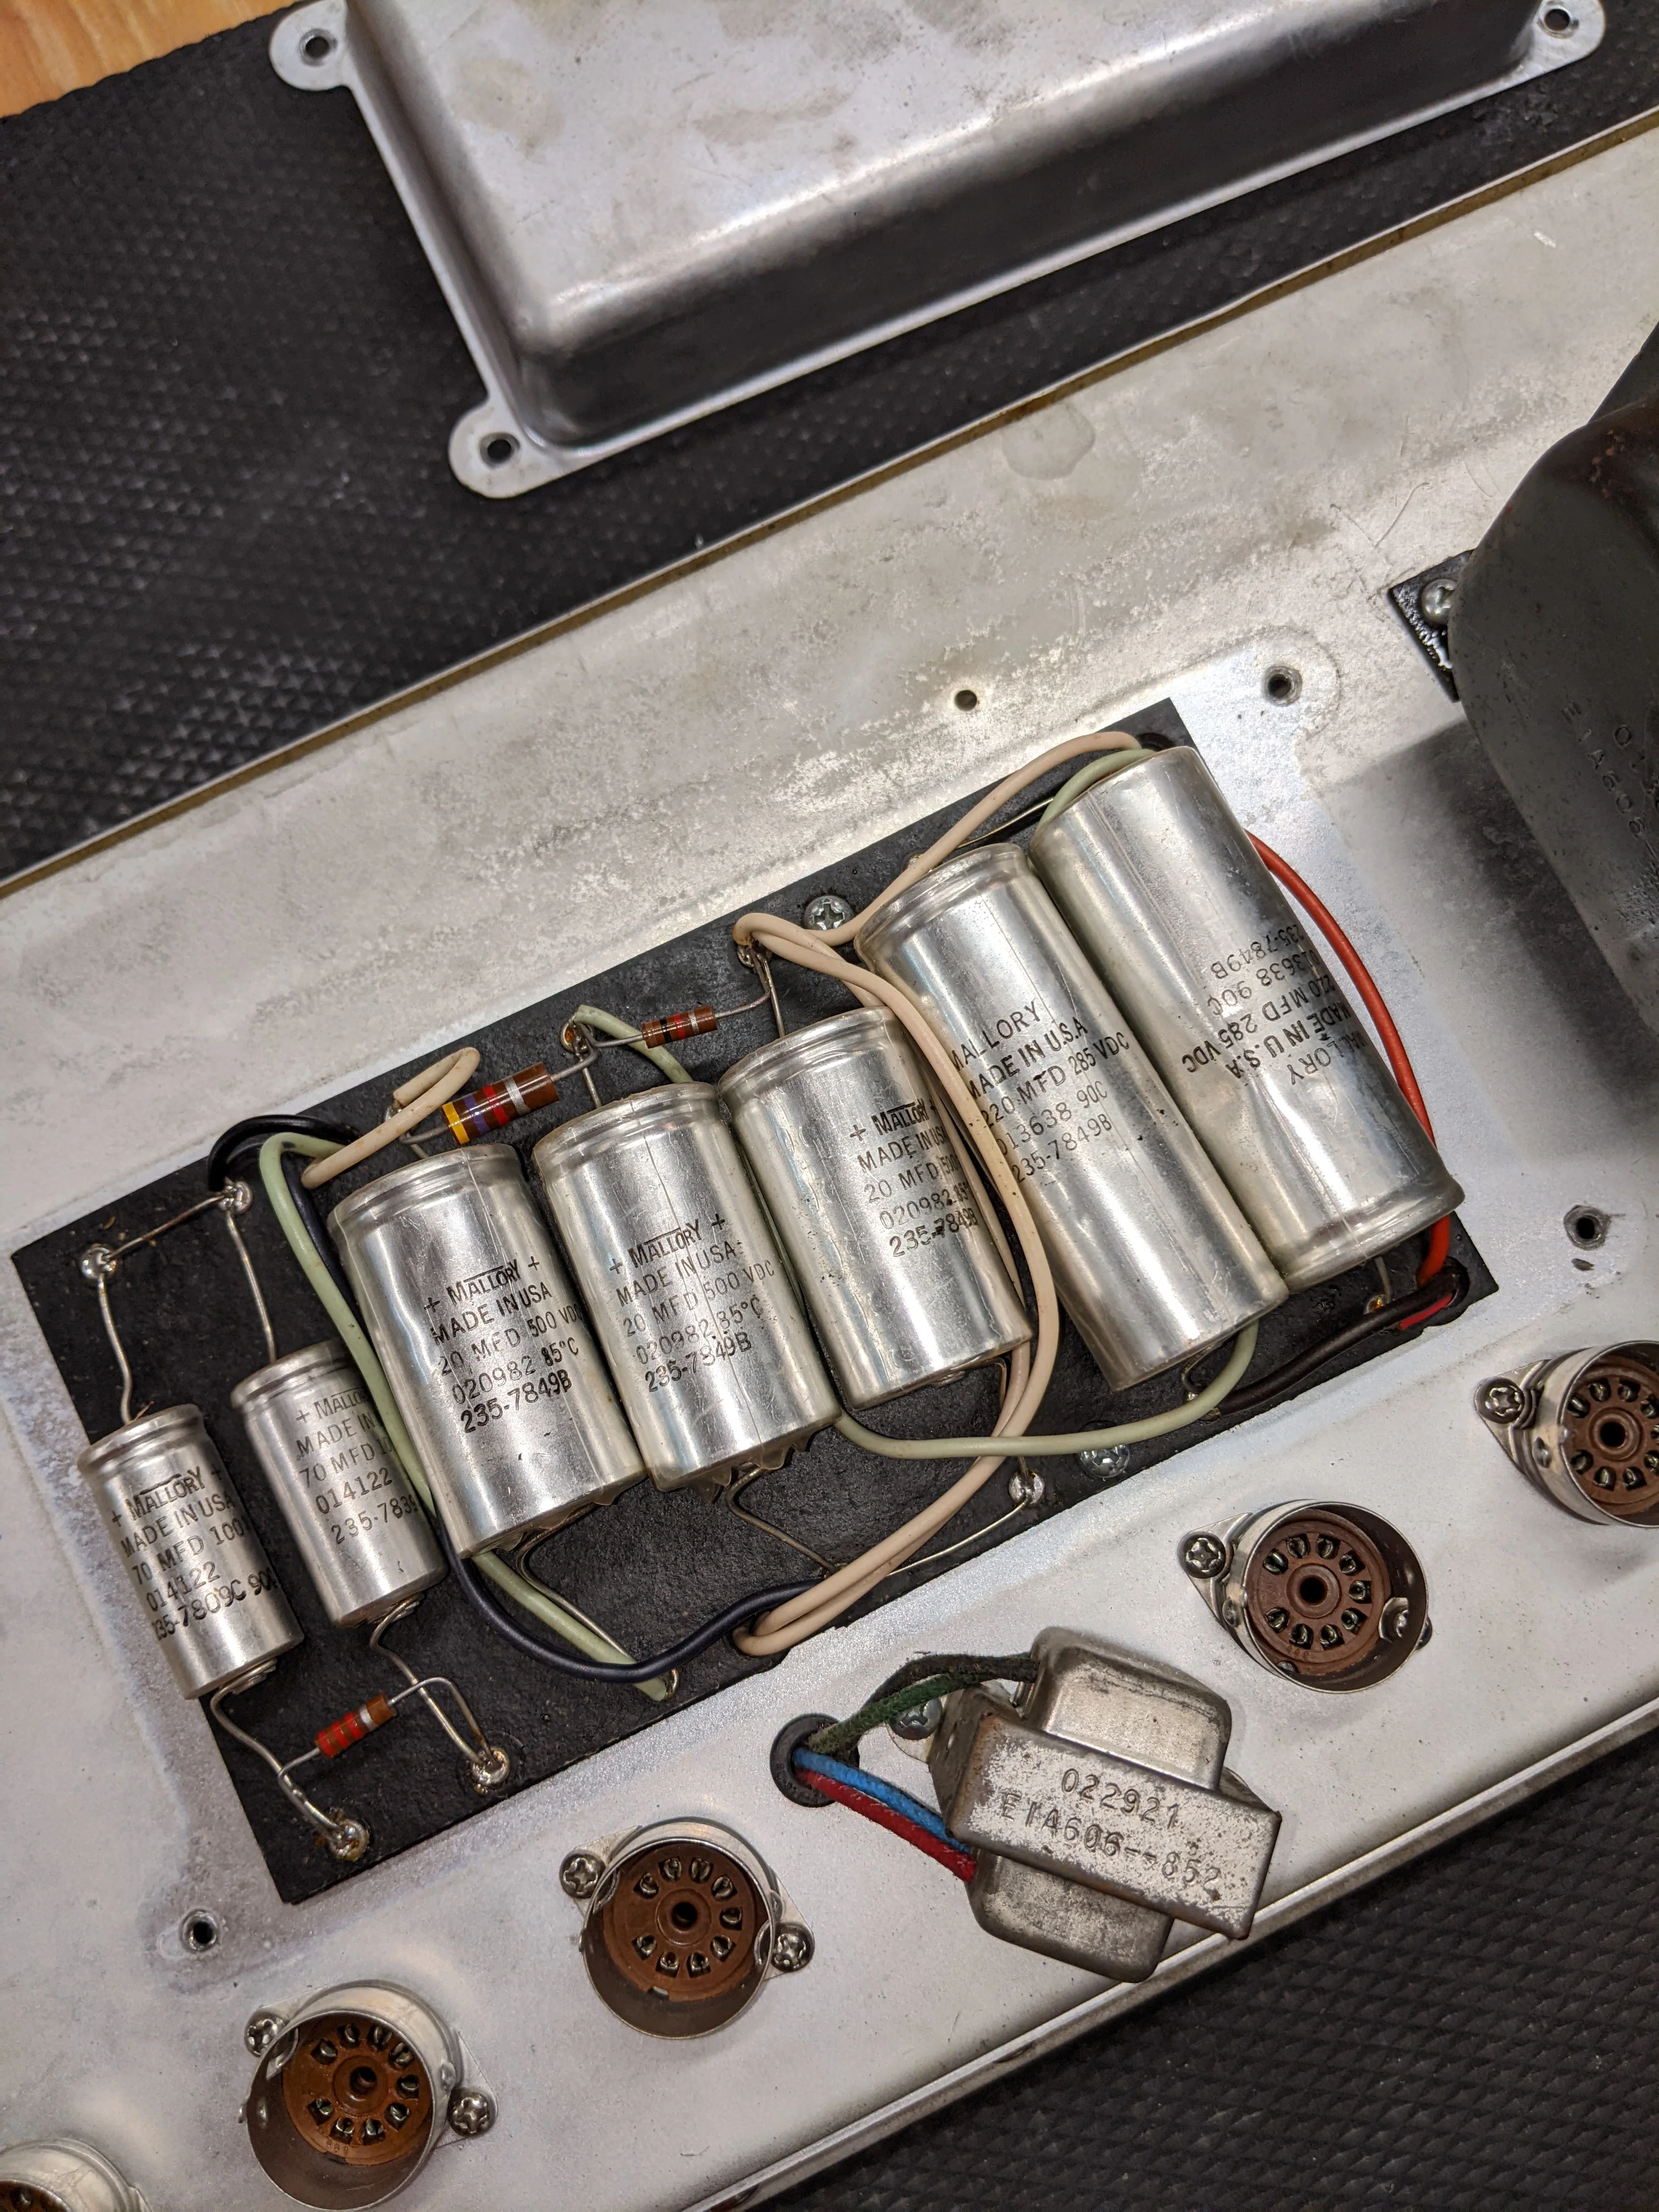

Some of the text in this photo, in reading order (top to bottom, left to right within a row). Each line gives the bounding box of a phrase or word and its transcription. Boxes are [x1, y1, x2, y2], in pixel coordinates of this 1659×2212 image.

[1207, 981, 1252, 1016] 90C
[1261, 988, 1309, 1022] MFD
[1306, 1000, 1350, 1034] MADE
[1019, 1040, 1045, 1066] IN
[1216, 1013, 1259, 1048] 285
[1283, 1020, 1309, 1047] IN
[980, 1029, 1130, 1126] 220 MFD 285 VDC
[1182, 1040, 1222, 1073] VDC
[872, 1099, 929, 1136] MALLORY
[995, 1080, 1108, 1154] 013638 90C
[857, 1136, 915, 1173] MADE
[916, 1131, 932, 1150] IN
[1009, 1112, 1114, 1182] 235-7849B
[864, 1178, 893, 1203] 20
[899, 1160, 940, 1190] MFD
[627, 1219, 706, 1267] MALLORY
[447, 1259, 520, 1306] MALLORY
[614, 1240, 736, 1306] MADE IN USA
[431, 1280, 551, 1345] MADE IN USA
[622, 1260, 774, 1336] 20 MFD 500 VDC
[436, 1350, 465, 1375] 20
[471, 1326, 522, 1362] MFD
[527, 1311, 557, 1337] 500
[634, 1318, 713, 1364] 020982
[642, 1330, 753, 1392] 235-7849B
[451, 1353, 535, 1405] 020982
[460, 1368, 573, 1434] 235-7849B
[297, 1411, 374, 1454] MADE IN
[300, 1463, 328, 1487] 70
[330, 1440, 376, 1474] MFD
[125, 1465, 207, 1520] MALLORY
[314, 1465, 392, 1514] 014122
[119, 1488, 234, 1556] MADE IN USA
[132, 1561, 153, 1583] 70
[156, 1534, 206, 1570] MFD
[144, 1560, 221, 1611] 014122
[1061, 1768, 1180, 1830] 022921
